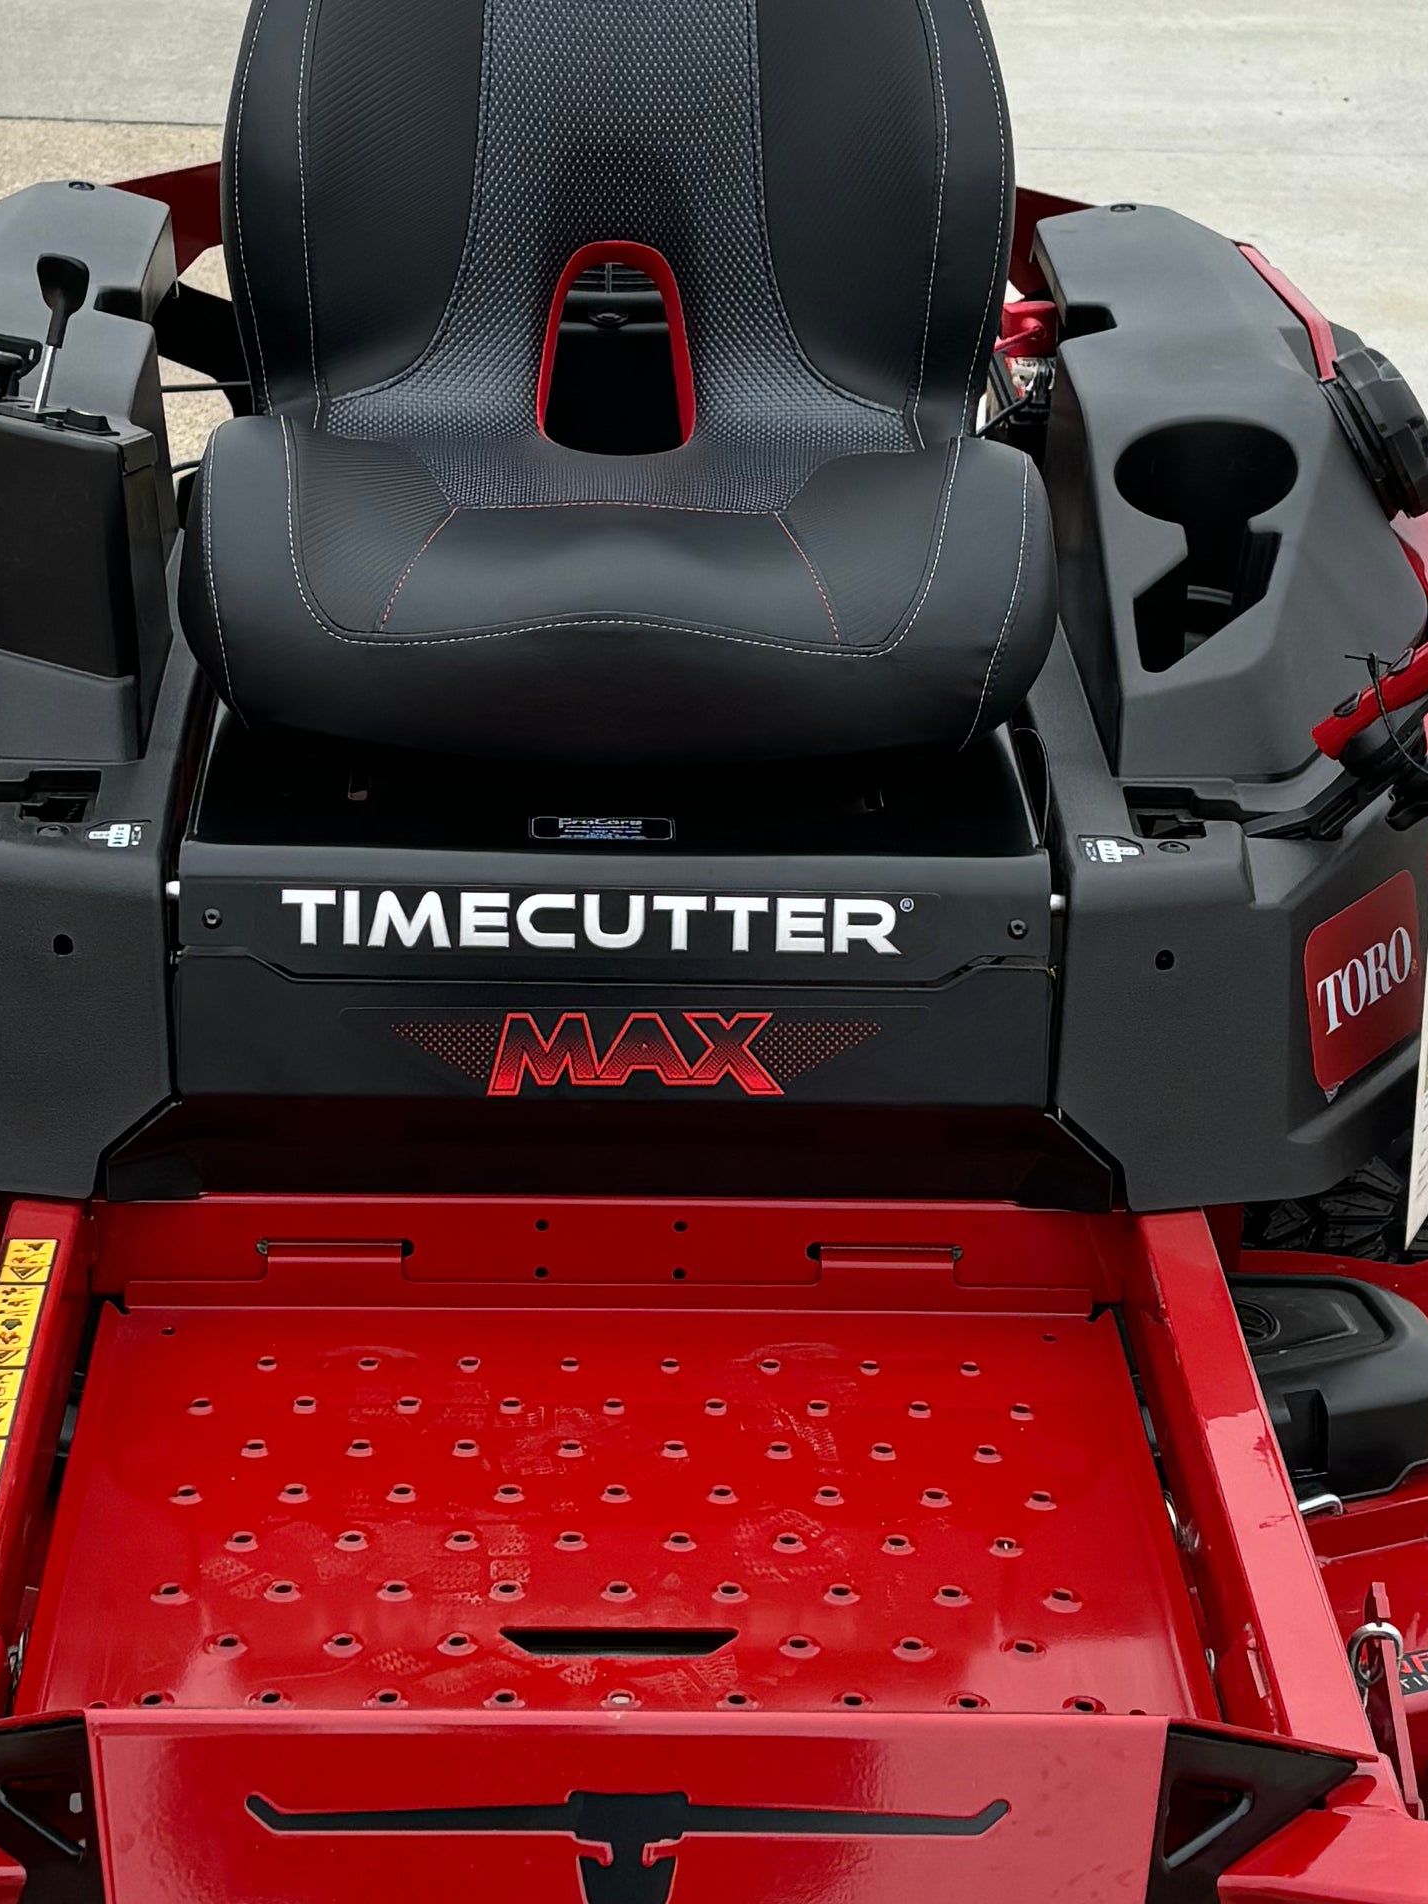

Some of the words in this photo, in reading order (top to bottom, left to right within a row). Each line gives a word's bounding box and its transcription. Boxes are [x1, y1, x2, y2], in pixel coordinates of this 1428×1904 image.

[281, 888, 902, 954] TIMECUTTER
[1317, 926, 1412, 1035] TORO
[486, 1011, 785, 1097] MAX
